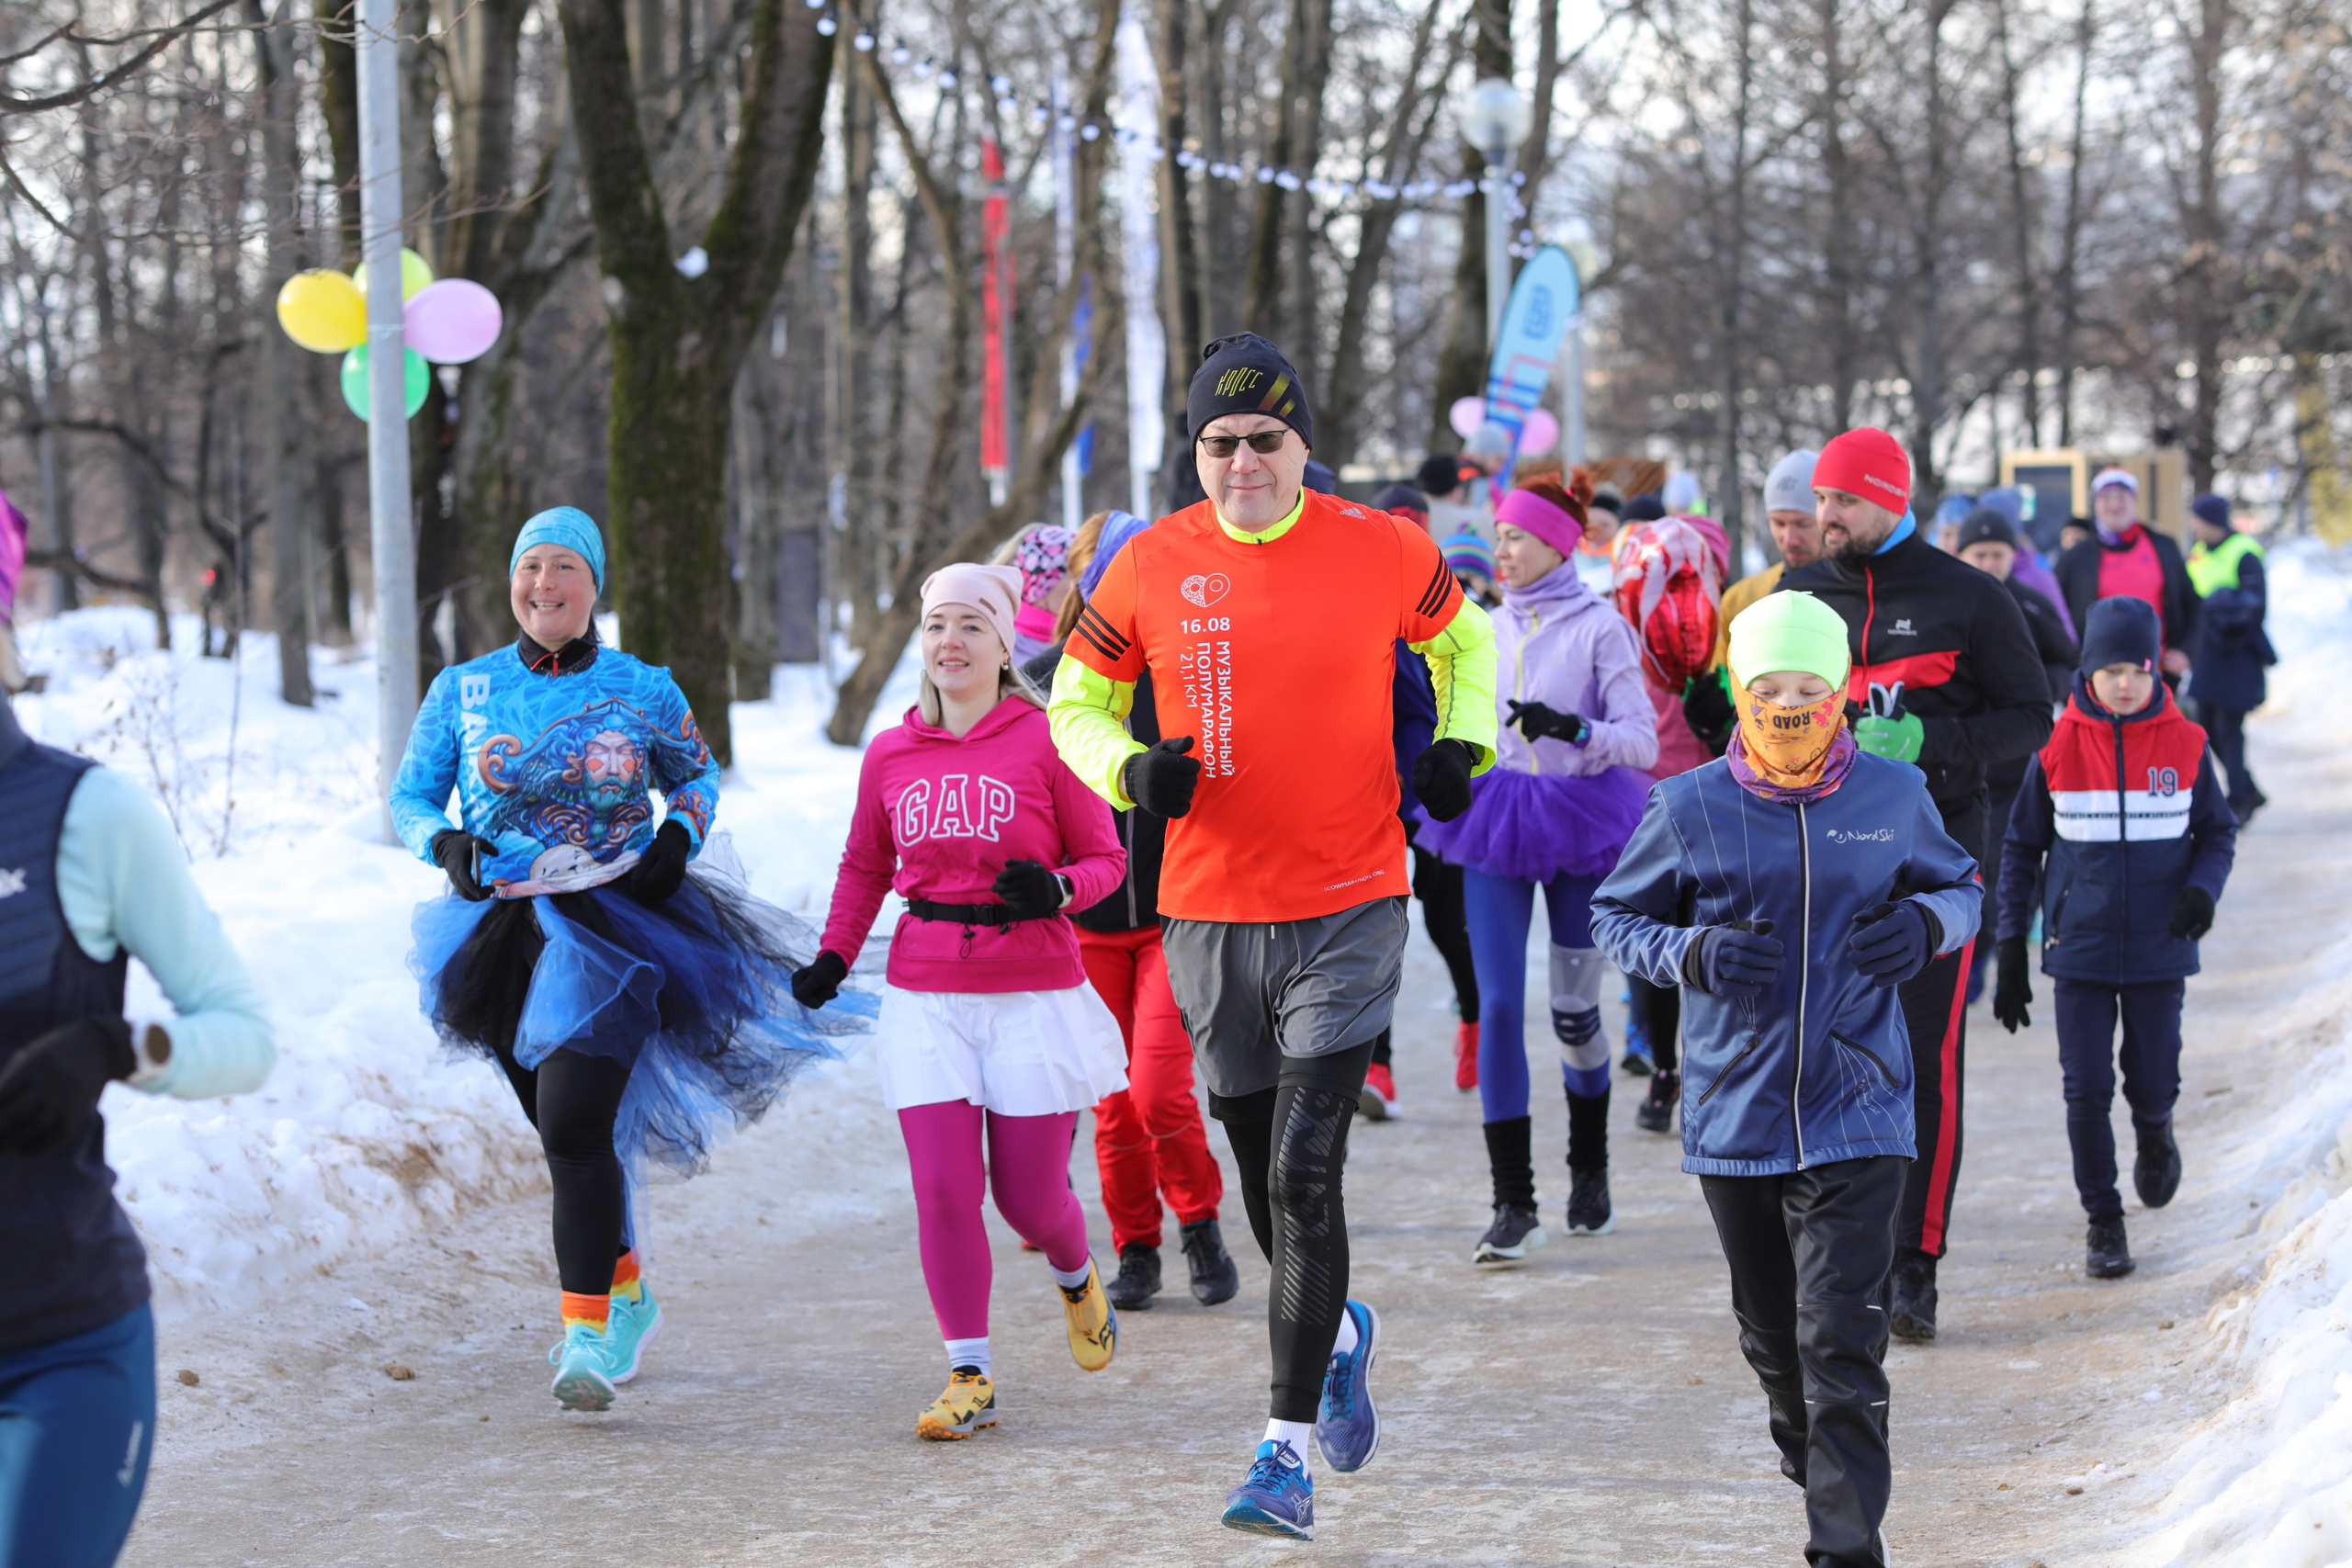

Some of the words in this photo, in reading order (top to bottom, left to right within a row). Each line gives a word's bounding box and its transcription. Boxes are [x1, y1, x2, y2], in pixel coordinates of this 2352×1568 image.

[1181, 616, 1230, 634] 16.08
[1197, 642, 1216, 779] ПОЛУМАРАФОН
[1216, 640, 1236, 776] МУЗЫКАЛЬНЫЙ
[1772, 711, 1811, 729] ROAD
[2147, 766, 2178, 797] 19
[896, 773, 1015, 847] GAP
